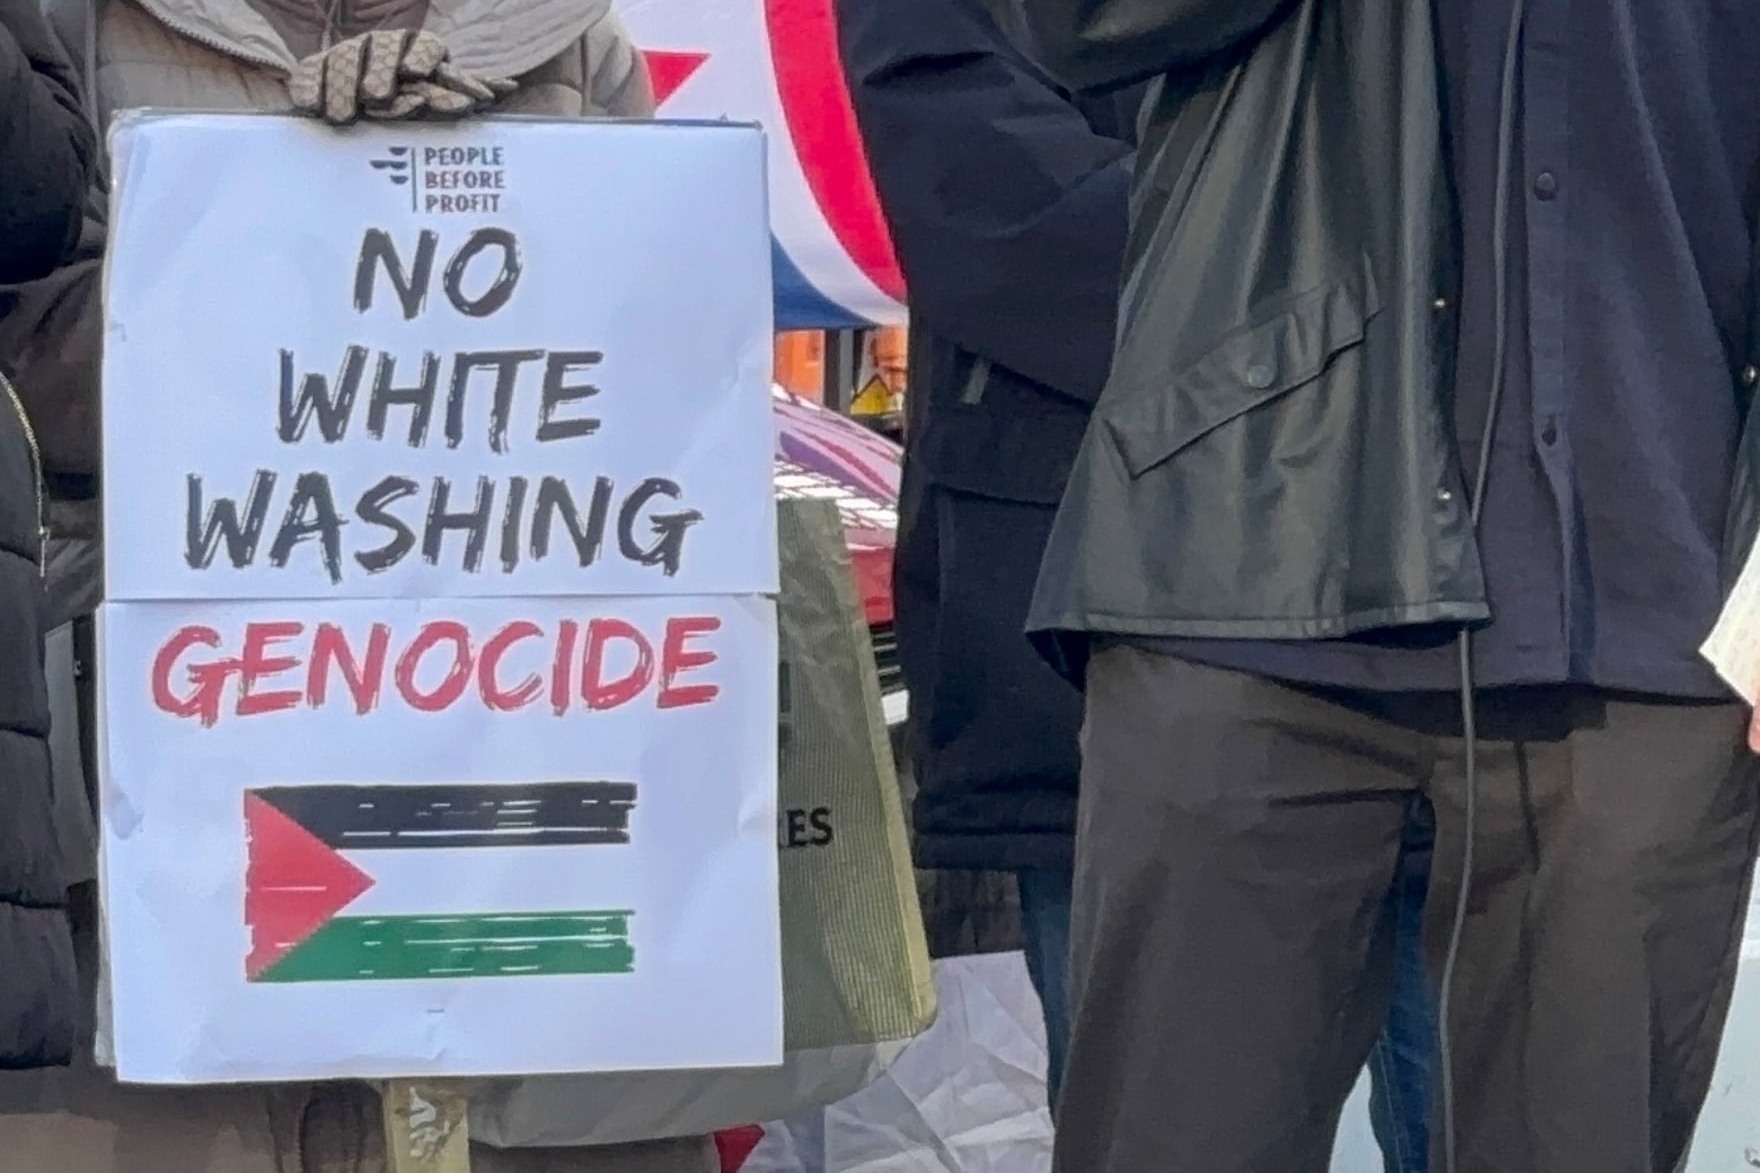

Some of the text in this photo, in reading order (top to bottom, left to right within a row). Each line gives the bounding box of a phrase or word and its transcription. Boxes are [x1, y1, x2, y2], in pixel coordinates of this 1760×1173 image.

[423, 146, 504, 166] PEOPLE
[424, 170, 506, 189] BEFORE
[424, 193, 502, 214] PROFIT
[353, 226, 522, 320] NO
[276, 345, 603, 454] WHITE
[184, 469, 703, 583] WASHING
[151, 616, 722, 727] GENOCIDE
[778, 806, 836, 849] ES
